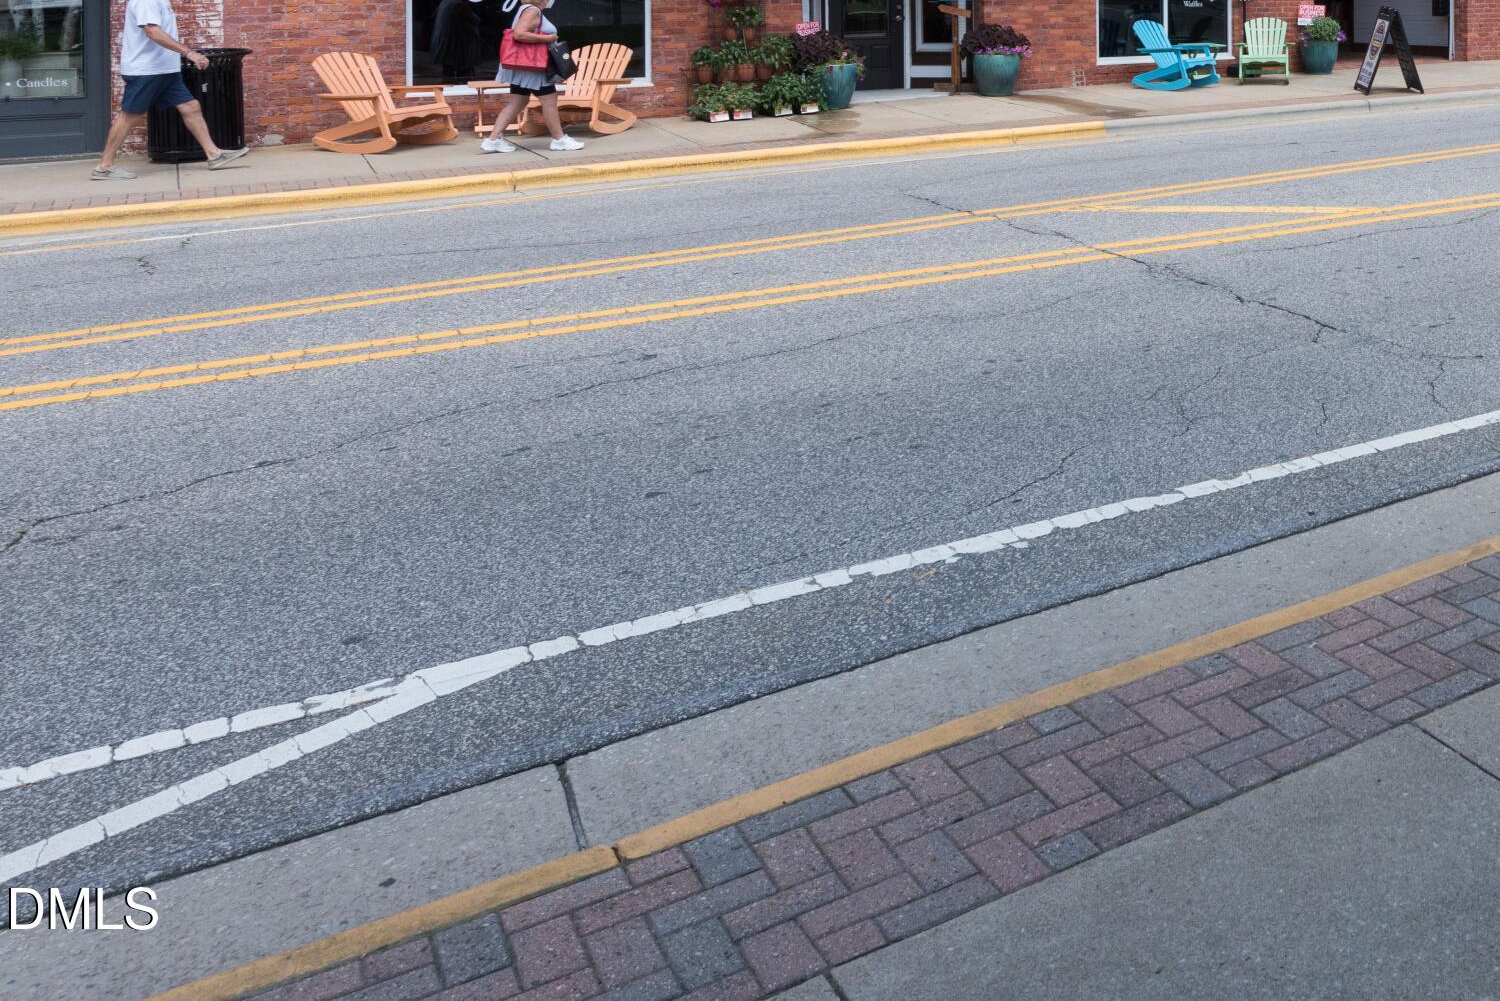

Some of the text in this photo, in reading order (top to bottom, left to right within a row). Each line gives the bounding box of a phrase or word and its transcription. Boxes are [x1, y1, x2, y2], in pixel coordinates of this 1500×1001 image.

[1299, 9, 1325, 17] BUSINESS
[797, 21, 819, 30] OPEN FOR
[16, 76, 69, 88] Candles
